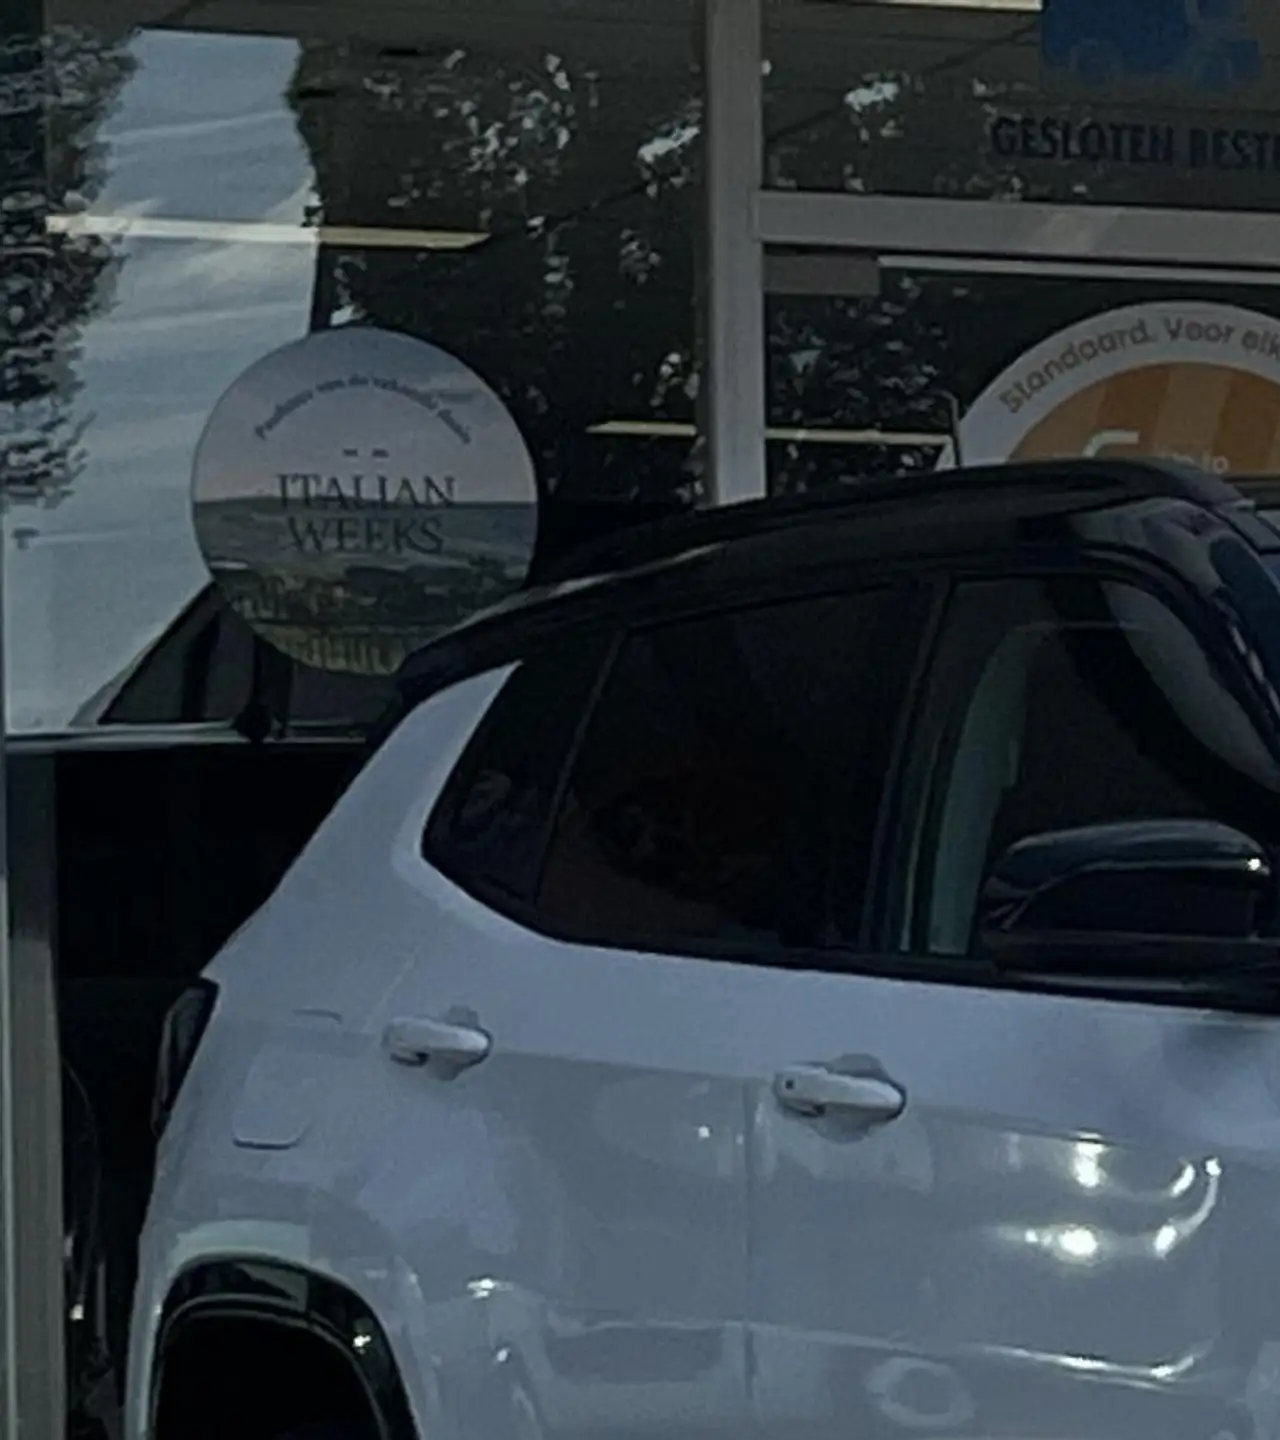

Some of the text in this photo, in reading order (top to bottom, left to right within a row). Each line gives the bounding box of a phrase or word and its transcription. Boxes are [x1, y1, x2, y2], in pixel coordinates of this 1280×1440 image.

[991, 115, 1174, 164] GESLOTEN
[1162, 317, 1236, 344] Voor
[276, 473, 456, 508] ITALIAN
[286, 514, 444, 553] WEEKS
